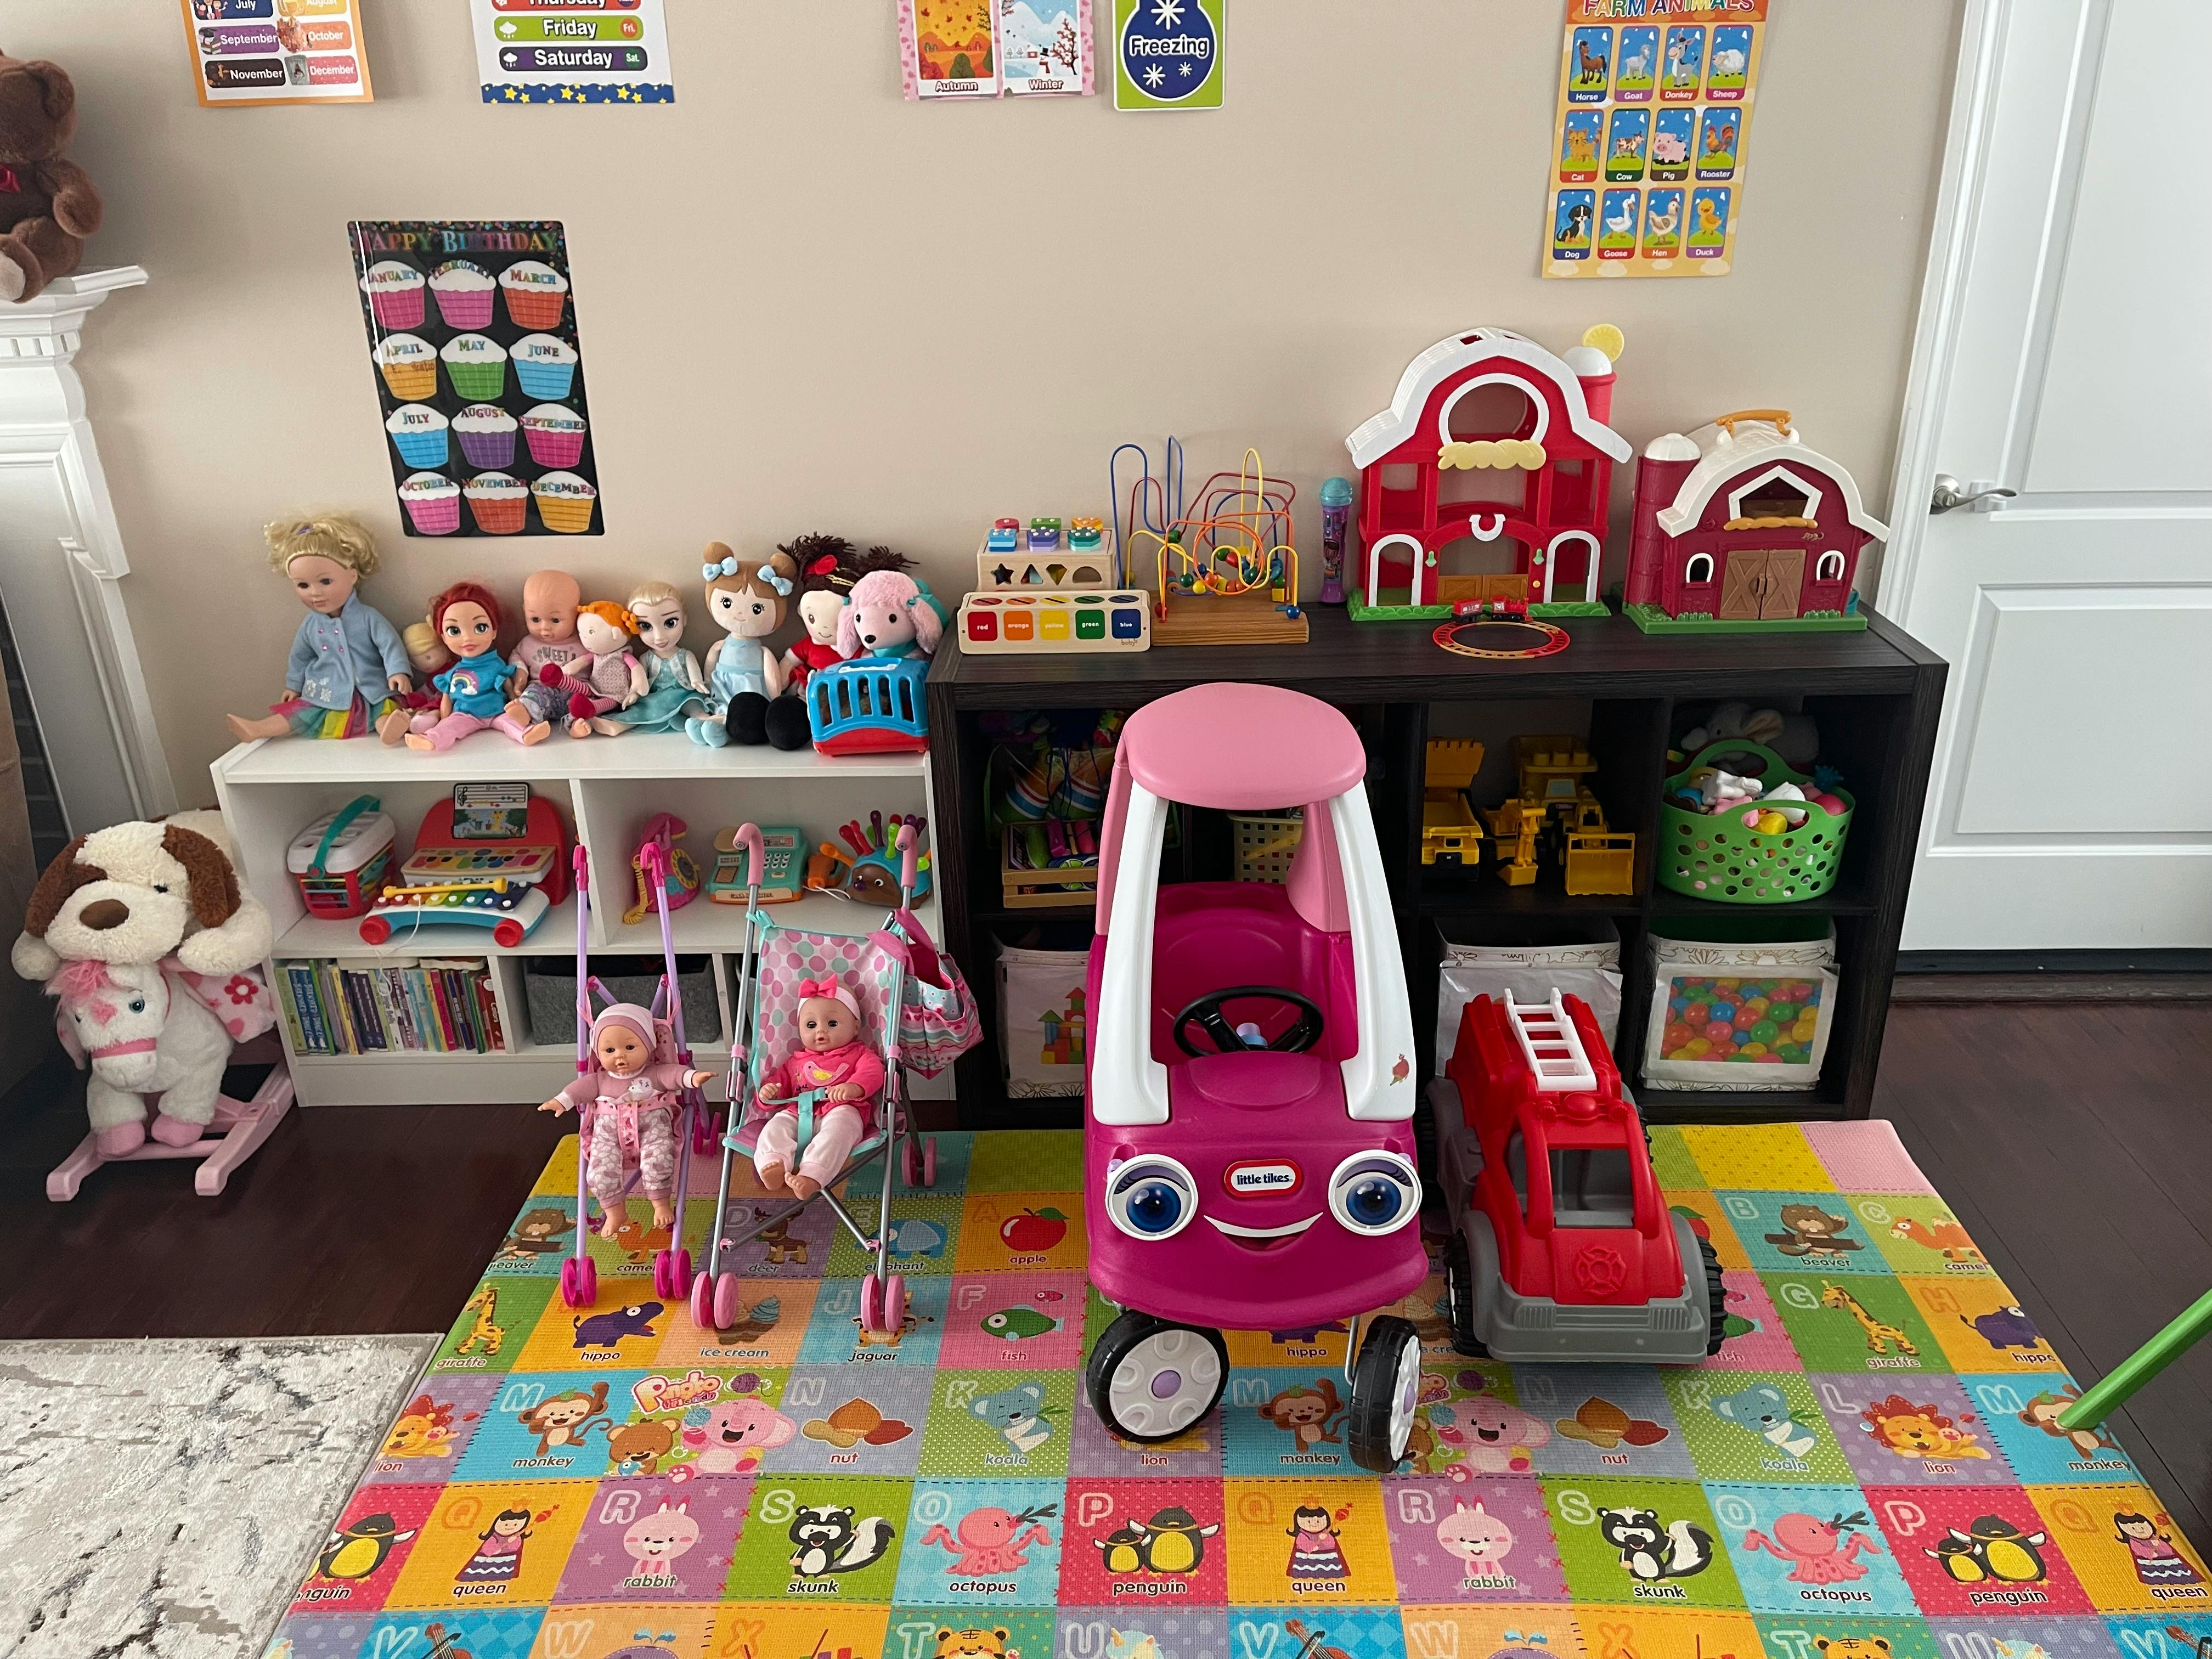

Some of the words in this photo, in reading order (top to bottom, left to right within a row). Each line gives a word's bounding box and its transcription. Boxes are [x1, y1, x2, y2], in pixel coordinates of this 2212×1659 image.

[235, 0, 256, 10] July
[1583, 0, 1646, 17] FARM
[1651, 0, 1754, 14] ANIMALS
[543, 19, 596, 38] Friday
[221, 32, 278, 46] September
[308, 31, 343, 42] October
[1131, 37, 1208, 57] Freezing
[534, 49, 612, 69] Saturday
[230, 69, 283, 80] November
[309, 65, 354, 76] December
[935, 81, 978, 92] Autumn
[1029, 78, 1064, 91] Winter
[1624, 92, 1643, 100] Goat
[1664, 91, 1694, 100] Donkey
[1713, 91, 1737, 99] Sheep
[1571, 173, 1584, 182] Cat
[1662, 172, 1675, 181] Pig
[442, 230, 557, 252] BIRTHDAY
[1565, 251, 1580, 259] Dog
[510, 269, 557, 284] MARCH
[458, 340, 486, 352] MAY
[528, 344, 559, 357] JUNE
[401, 412, 430, 425] JULY
[461, 408, 505, 418] AUGUST
[518, 416, 588, 430] SEPTEMBER
[402, 478, 453, 492] OCTOBER
[461, 478, 527, 489] NOVEMBER
[532, 481, 597, 496] DECEMBER
[537, 647, 568, 663] SWEET
[1237, 1174, 1262, 1185] little
[1263, 1173, 1289, 1183] tikes
[1725, 1198, 1759, 1220] B
[1010, 1255, 1046, 1265] apple
[1801, 1257, 1850, 1267] beaver
[748, 1264, 780, 1273] deer
[1945, 1262, 1988, 1271] camel
[957, 1285, 986, 1311] F
[1920, 1288, 1962, 1313] H
[581, 1352, 620, 1362] hippo
[701, 1348, 720, 1356] ice
[849, 1351, 898, 1362] jaguar
[1001, 1351, 1026, 1361] fish
[1286, 1347, 1327, 1358] hippo
[435, 1357, 486, 1369] giraffe
[1866, 1358, 1920, 1369] giraffe
[791, 1378, 826, 1405] N
[500, 1384, 545, 1412] M
[1821, 1383, 1860, 1413] L
[1977, 1385, 2027, 1415] M
[513, 1457, 574, 1468] monkey
[831, 1453, 859, 1464] nut
[985, 1454, 1027, 1465] koala
[1141, 1454, 1169, 1465] lion
[1280, 1453, 1341, 1465] monkey
[1602, 1453, 1628, 1464] nut
[1761, 1459, 1808, 1470] koala
[374, 1462, 402, 1472] lion
[1923, 1461, 1955, 1473] lion
[2068, 1459, 2130, 1471] monkey
[600, 1490, 641, 1523] R
[760, 1490, 795, 1523] S
[914, 1491, 952, 1526] O
[1079, 1493, 1114, 1527] P
[1237, 1492, 1276, 1525] Q
[1398, 1489, 1435, 1523] R
[1557, 1490, 1595, 1525] S
[1715, 1495, 1757, 1529] O
[442, 1496, 482, 1530] Q
[1884, 1500, 1926, 1536] P
[2050, 1499, 2100, 1533] Q
[624, 1576, 676, 1587] rabbit
[788, 1581, 838, 1593] skunk
[1464, 1576, 1516, 1589] rabbit
[453, 1584, 506, 1596] queen
[950, 1581, 1017, 1595] octopus
[1113, 1580, 1186, 1596] penguin
[1292, 1582, 1346, 1594] queen
[1635, 1585, 1685, 1598] skunk
[2152, 1587, 2208, 1599] queen
[1801, 1589, 1872, 1604] octopus
[1970, 1589, 2047, 1606] penguin
